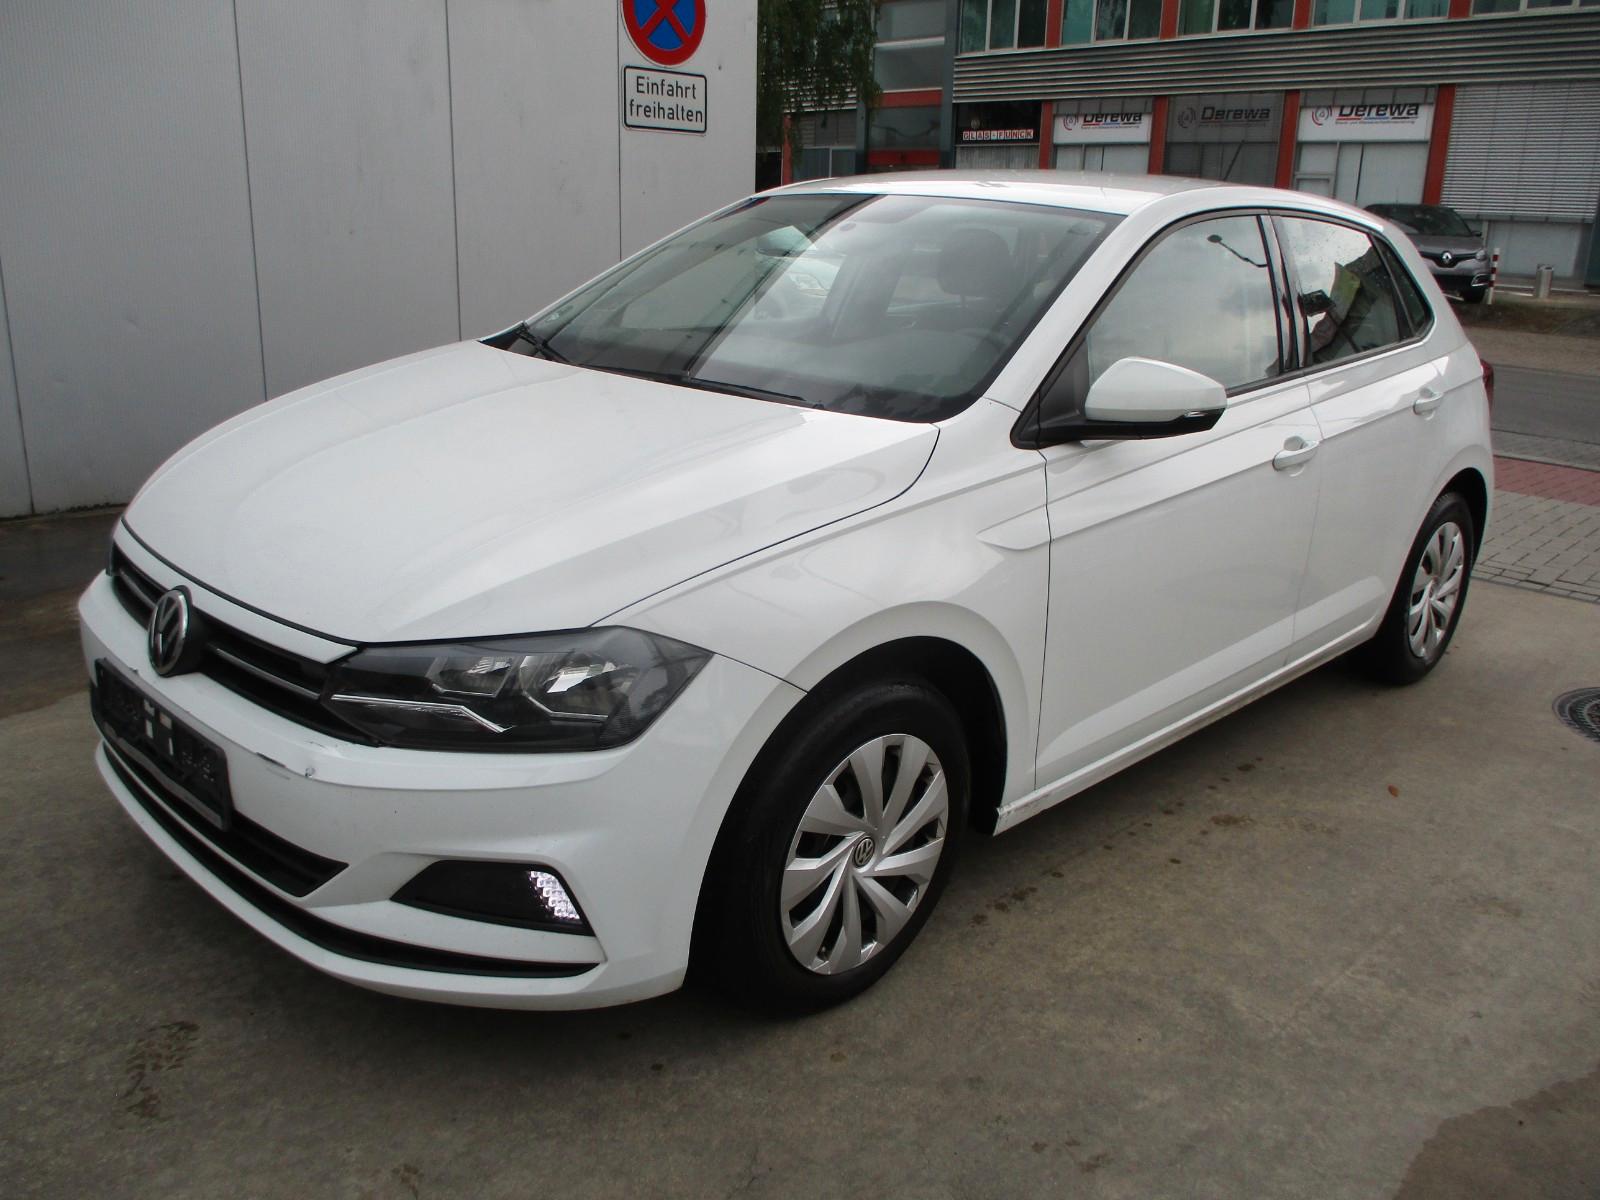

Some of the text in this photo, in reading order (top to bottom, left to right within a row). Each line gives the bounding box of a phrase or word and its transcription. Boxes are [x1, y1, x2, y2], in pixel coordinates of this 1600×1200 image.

[636, 75, 697, 100] Einfahrt
[629, 98, 704, 124] freihalten
[1083, 111, 1143, 123] Derewa
[1201, 106, 1271, 120] Derewa
[1339, 103, 1420, 118] Derewa
